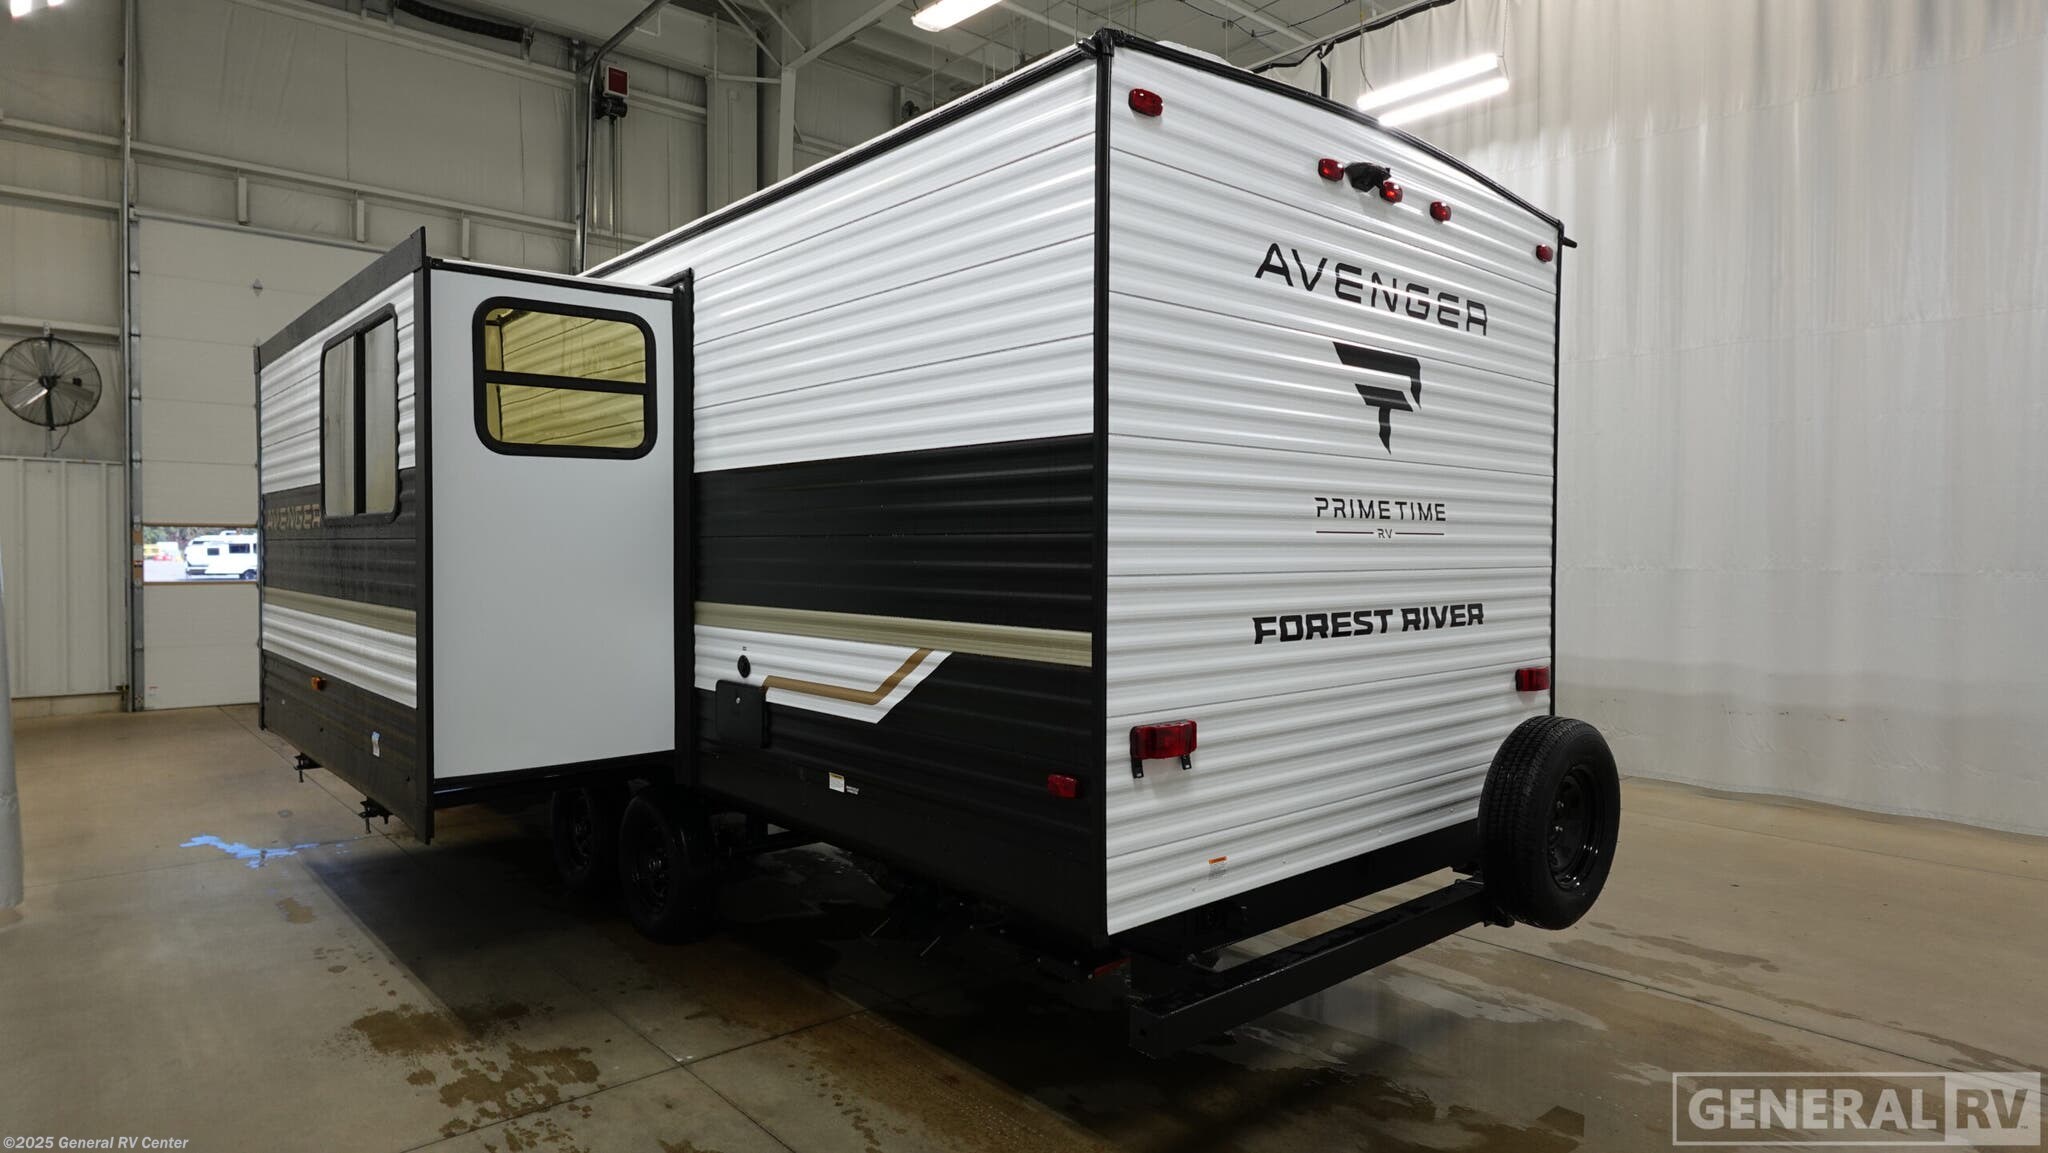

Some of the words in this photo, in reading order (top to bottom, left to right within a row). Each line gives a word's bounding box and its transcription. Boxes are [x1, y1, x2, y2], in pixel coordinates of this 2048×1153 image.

[1254, 242, 1488, 336] AVENGER
[265, 503, 321, 530] AVENGER
[1376, 528, 1393, 539] RV
[1252, 608, 1394, 645] FOREST
[1400, 602, 1484, 632] RIVER
